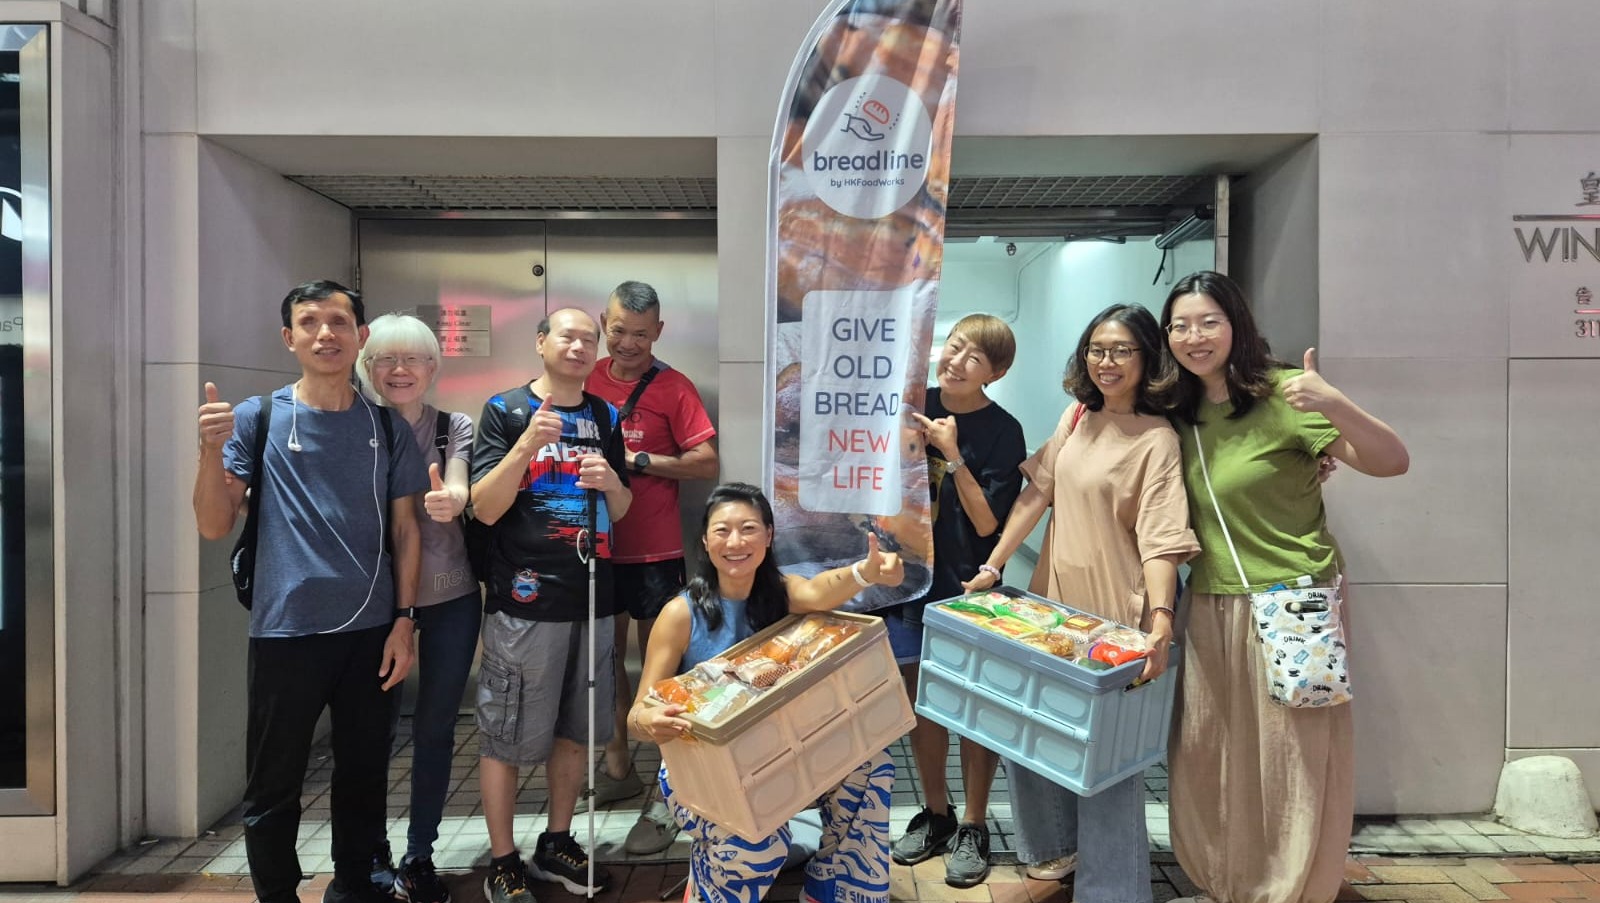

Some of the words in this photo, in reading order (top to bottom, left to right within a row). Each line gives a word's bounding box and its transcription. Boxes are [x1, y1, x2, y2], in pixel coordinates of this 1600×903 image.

[813, 150, 924, 171] breadline
[830, 178, 842, 188] by
[844, 177, 905, 187] HKFoodWorks
[1513, 226, 1600, 263] WIN
[832, 317, 896, 342] GIVE
[833, 355, 893, 379] OLD
[814, 392, 899, 416] BREAD
[828, 429, 891, 453] NEW
[833, 466, 884, 490] LIFE
[1283, 635, 1306, 644] DRINK
